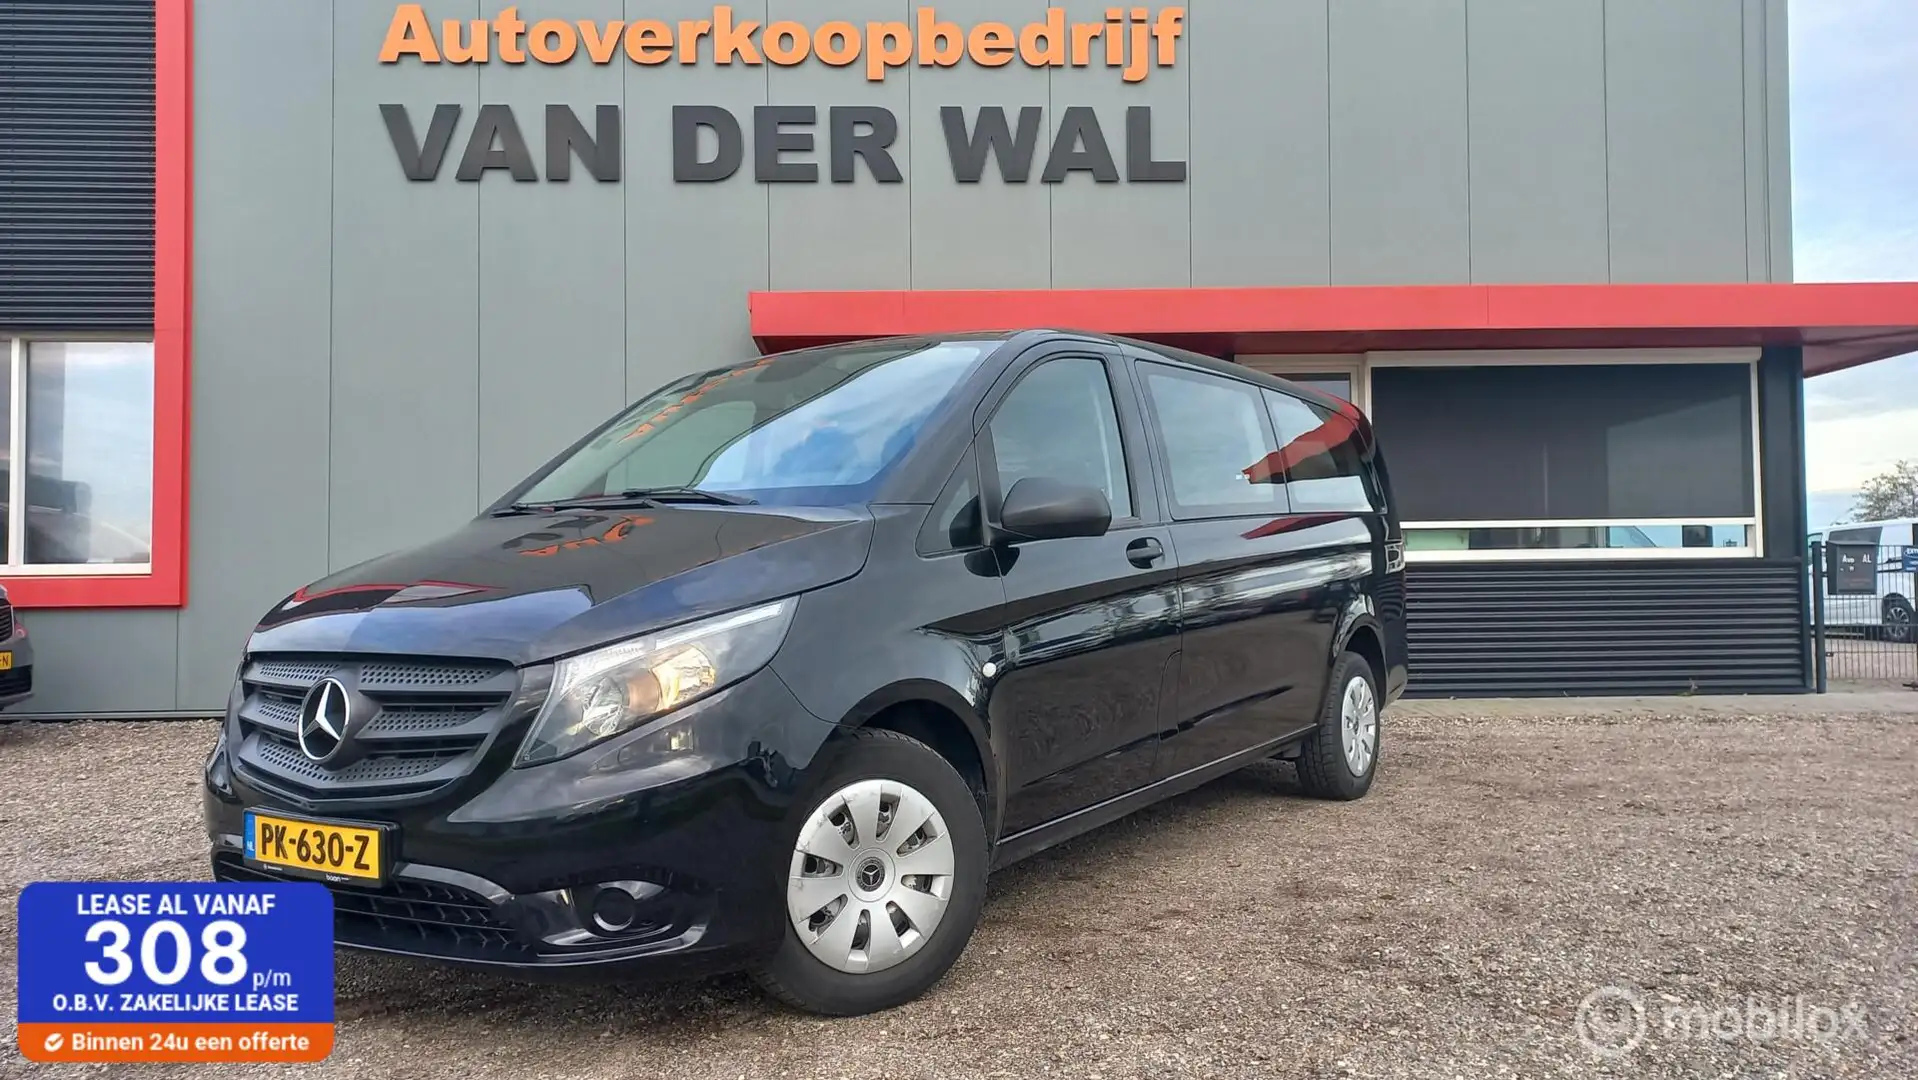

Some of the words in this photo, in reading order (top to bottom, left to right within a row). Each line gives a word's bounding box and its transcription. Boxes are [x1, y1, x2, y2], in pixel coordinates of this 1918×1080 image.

[379, 4, 1185, 82] Autoverkoopbedrijf
[379, 104, 622, 182] VAN
[672, 106, 904, 183] DER
[941, 107, 1187, 184] WAL
[260, 822, 370, 871] PK-630-Z
